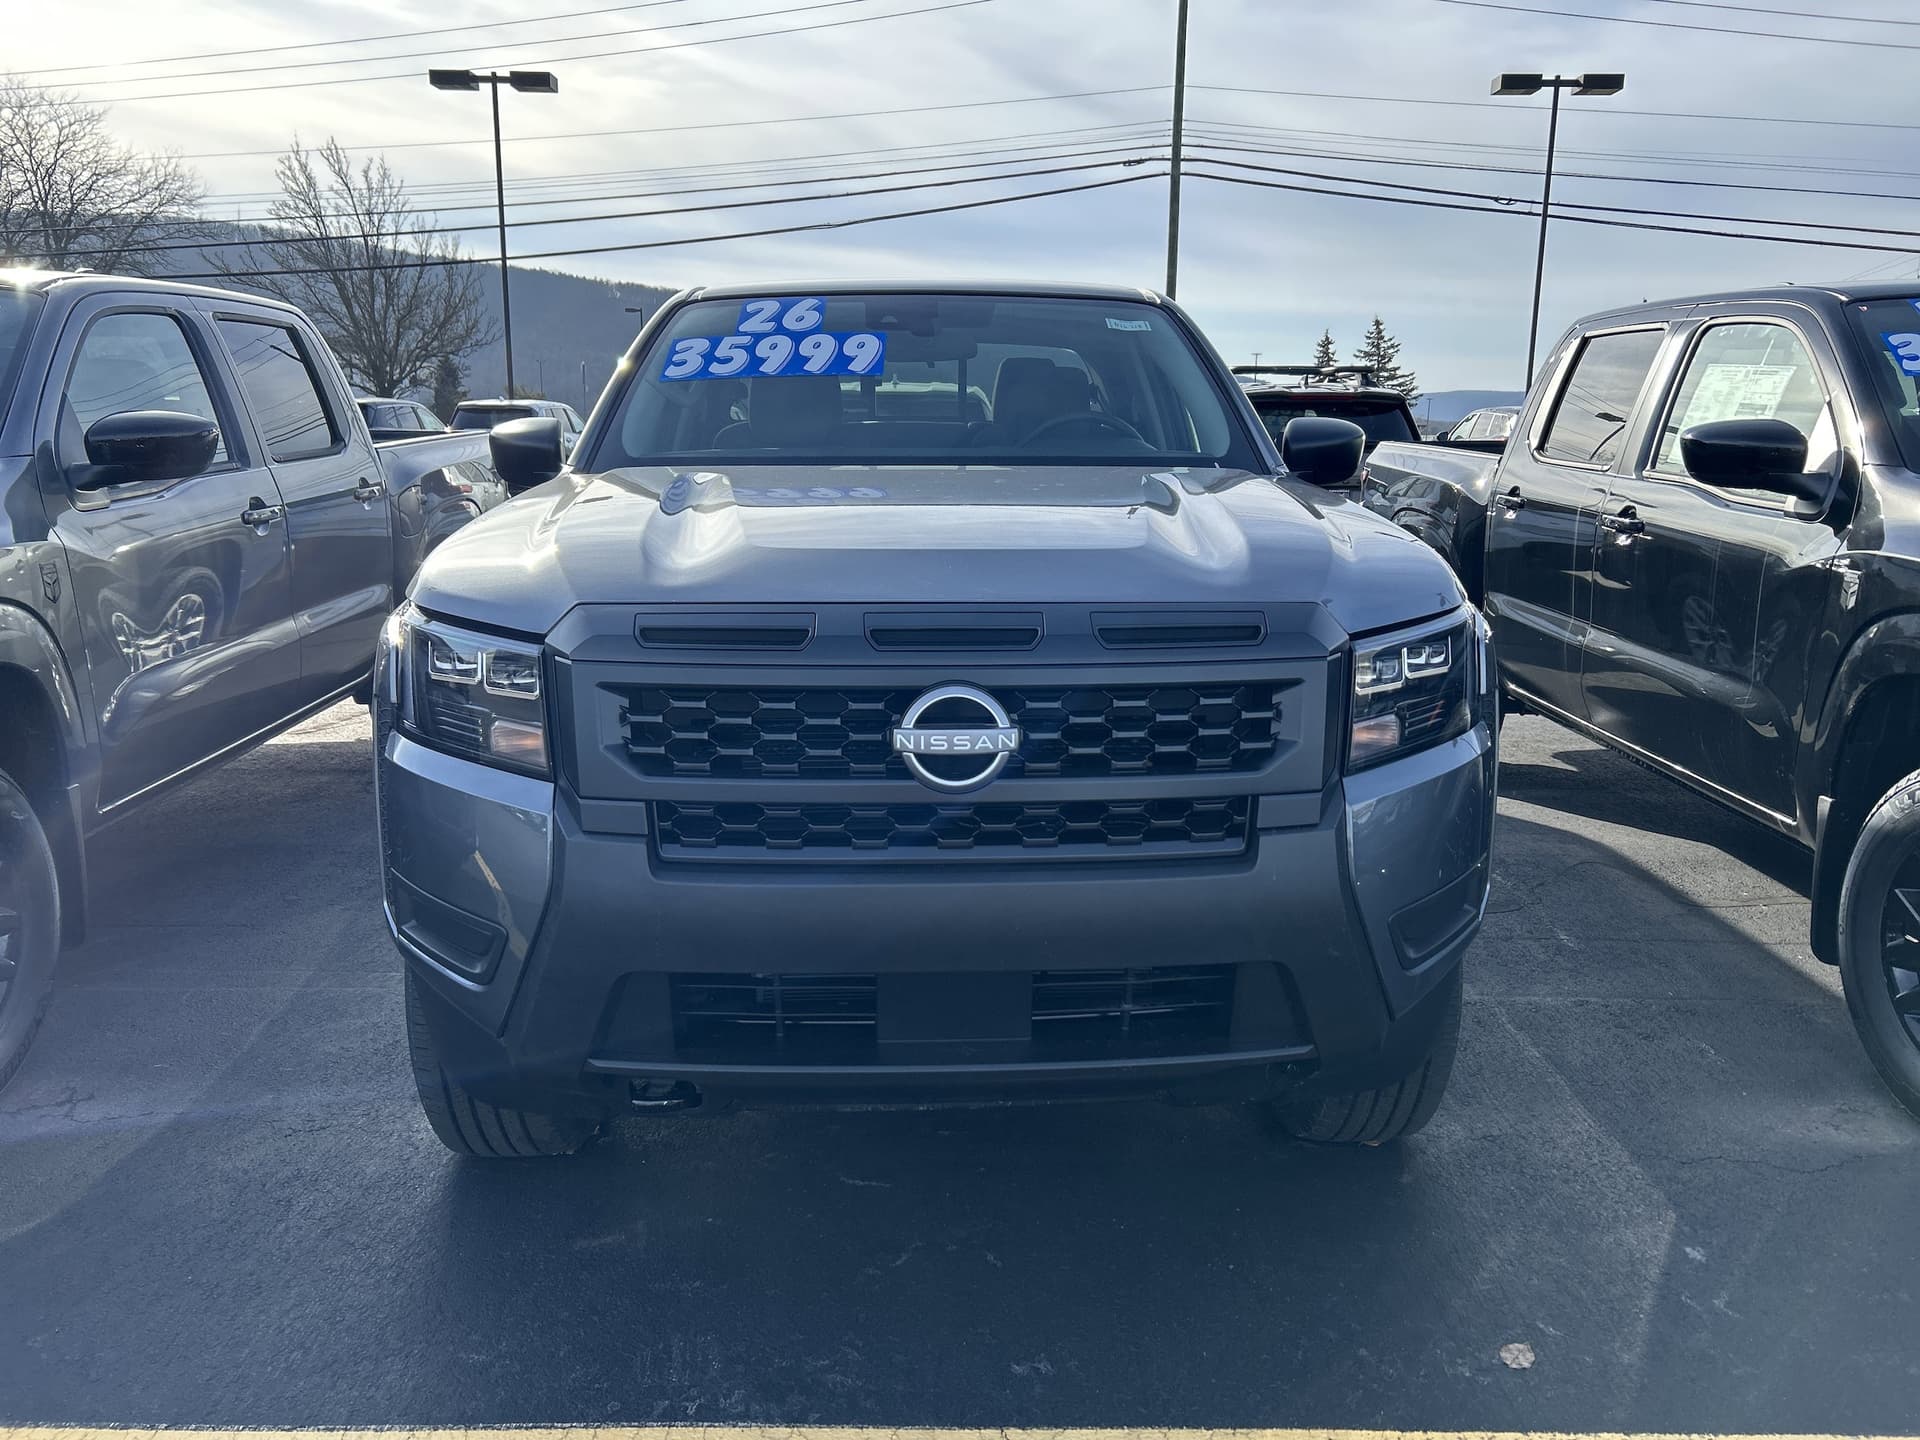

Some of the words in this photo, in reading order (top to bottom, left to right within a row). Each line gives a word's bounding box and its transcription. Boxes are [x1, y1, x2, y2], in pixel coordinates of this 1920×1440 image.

[738, 298, 822, 333] 26
[664, 334, 883, 378] 35999
[896, 733, 1017, 750] NISSAN
